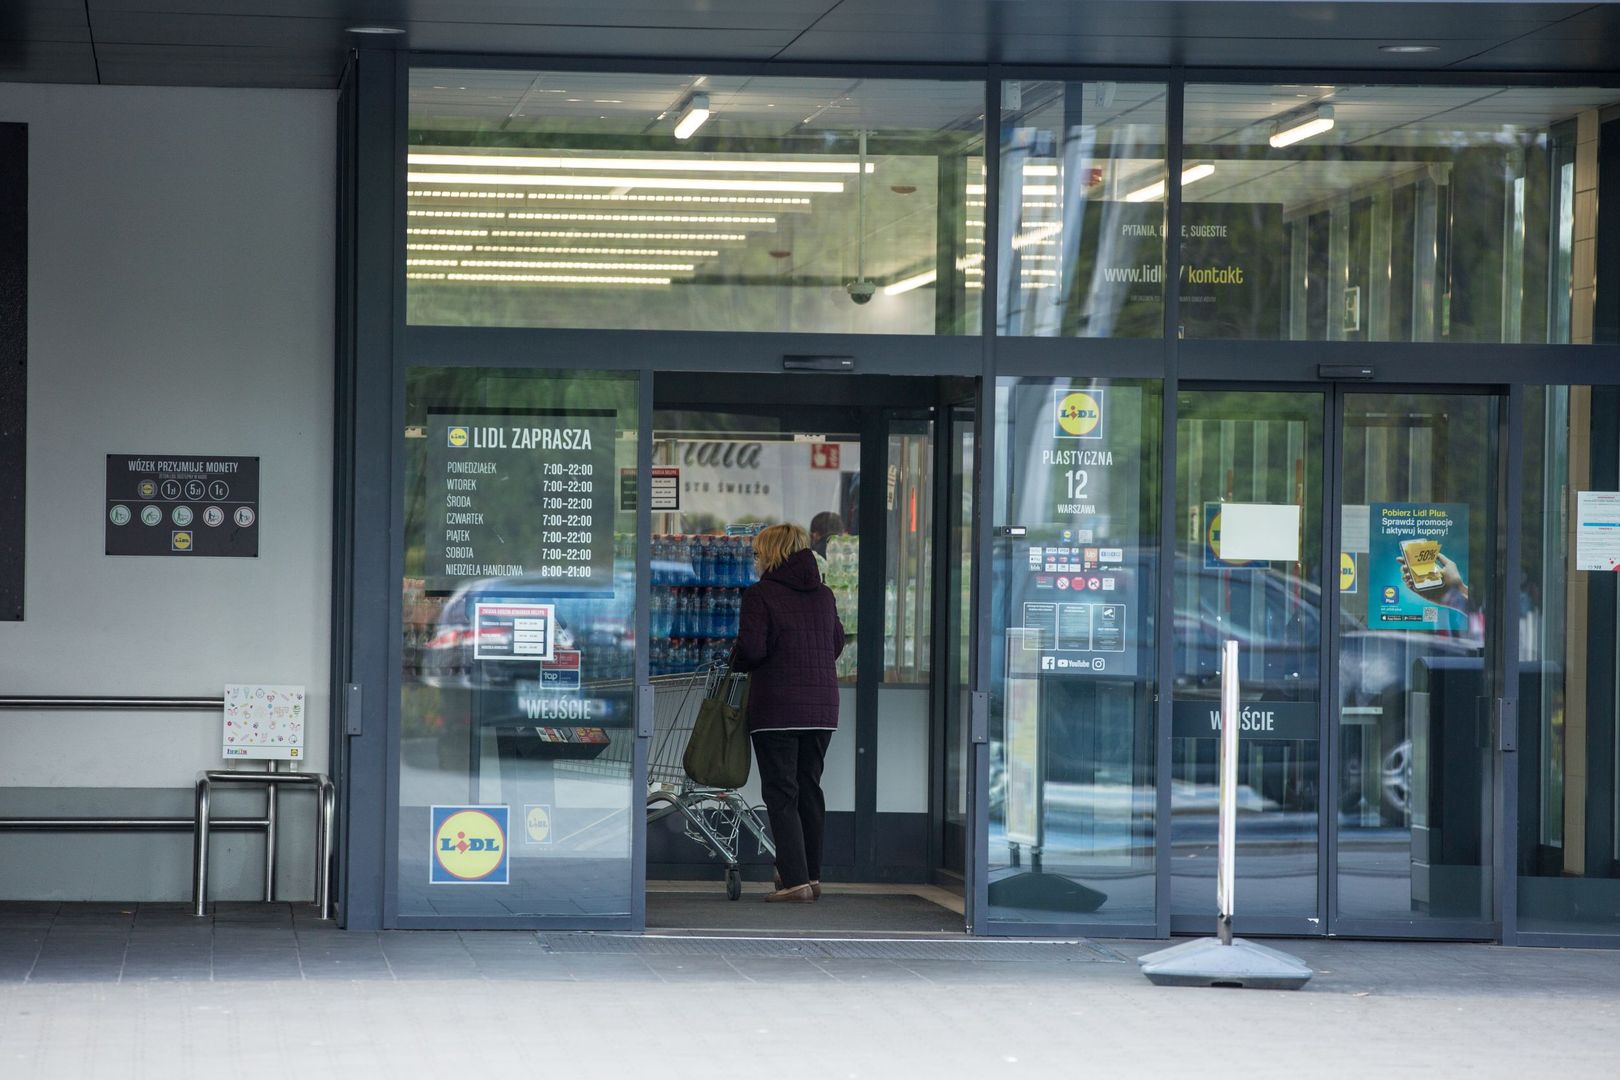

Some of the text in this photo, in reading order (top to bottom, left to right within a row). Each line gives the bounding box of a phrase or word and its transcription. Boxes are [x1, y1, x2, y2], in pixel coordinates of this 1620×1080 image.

[1122, 224, 1157, 238] PYTANIA,
[1190, 225, 1228, 238] SUGESTIE
[1188, 265, 1243, 284] kontakt
[473, 427, 592, 450] LIDL ZAPRASZA
[1042, 450, 1113, 466] PLASTYCZNA
[128, 458, 238, 473] WÓZEK PRZYJMUJE MONETY
[447, 462, 497, 474] PONIEDZIAŁEK
[446, 478, 477, 491] WTOREK
[1065, 470, 1088, 499] 12
[446, 493, 471, 508] ŚRODA
[1057, 504, 1096, 514] WARSZAWA
[1382, 509, 1411, 517] Pobierz
[1413, 509, 1428, 517] Lidl
[446, 513, 484, 525] CZWARTEK
[1381, 517, 1415, 527] Sprawdź
[446, 529, 470, 544] PIĄTEK
[1386, 527, 1416, 536] aktywuj
[1417, 527, 1449, 536] kupony!
[445, 547, 474, 559] SOBOTA
[1414, 549, 1437, 562] -50%
[445, 564, 482, 576] NIEDZIELA
[483, 565, 523, 577] HANDLOWA
[526, 695, 591, 720] WEJŚCIE
